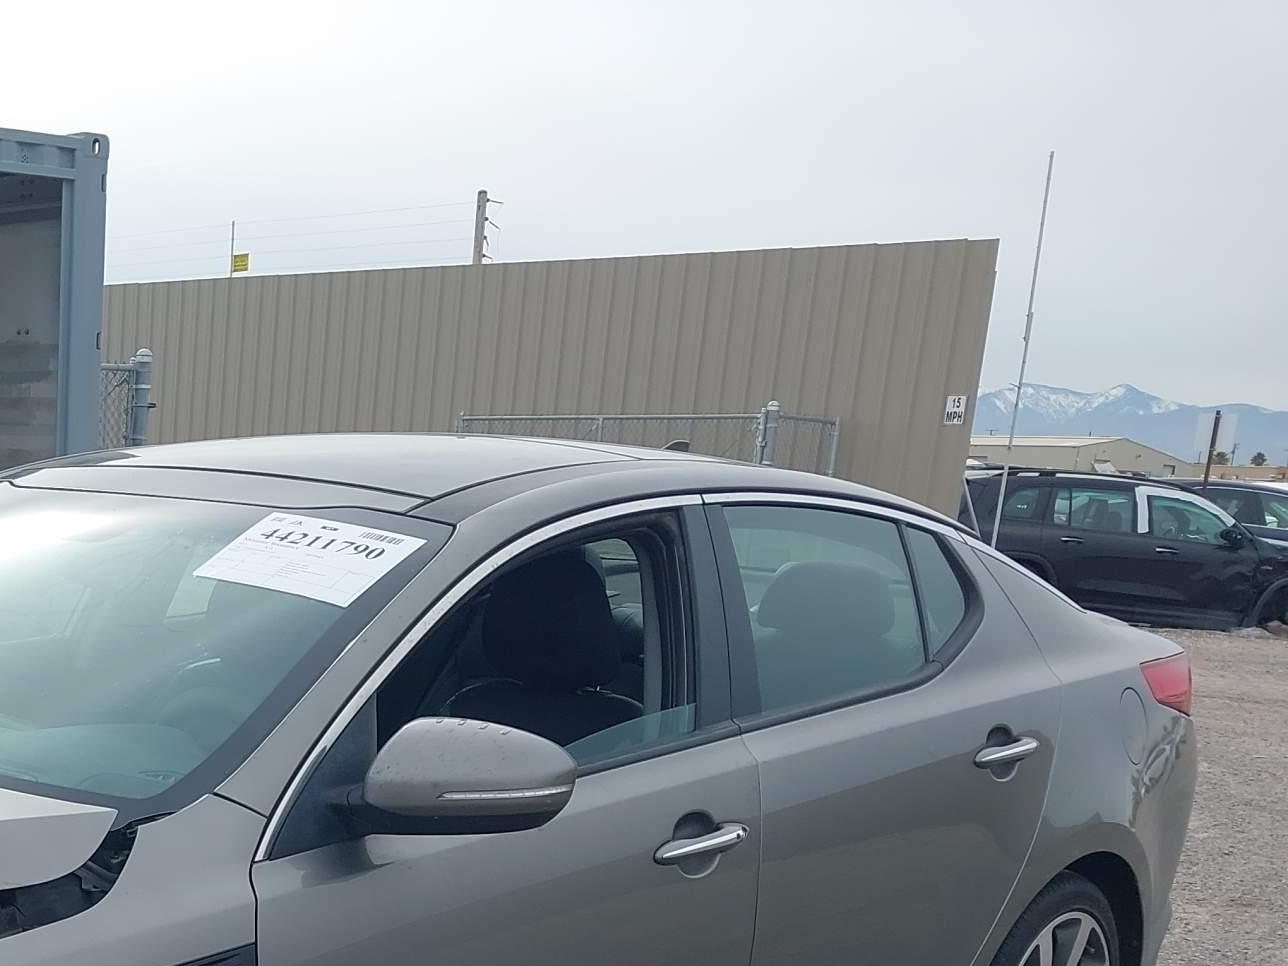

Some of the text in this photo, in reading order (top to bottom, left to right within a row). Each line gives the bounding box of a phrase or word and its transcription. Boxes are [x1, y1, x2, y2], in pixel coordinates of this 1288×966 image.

[952, 397, 961, 409] 15
[945, 410, 963, 423] MPH
[260, 528, 386, 560] 44211790
